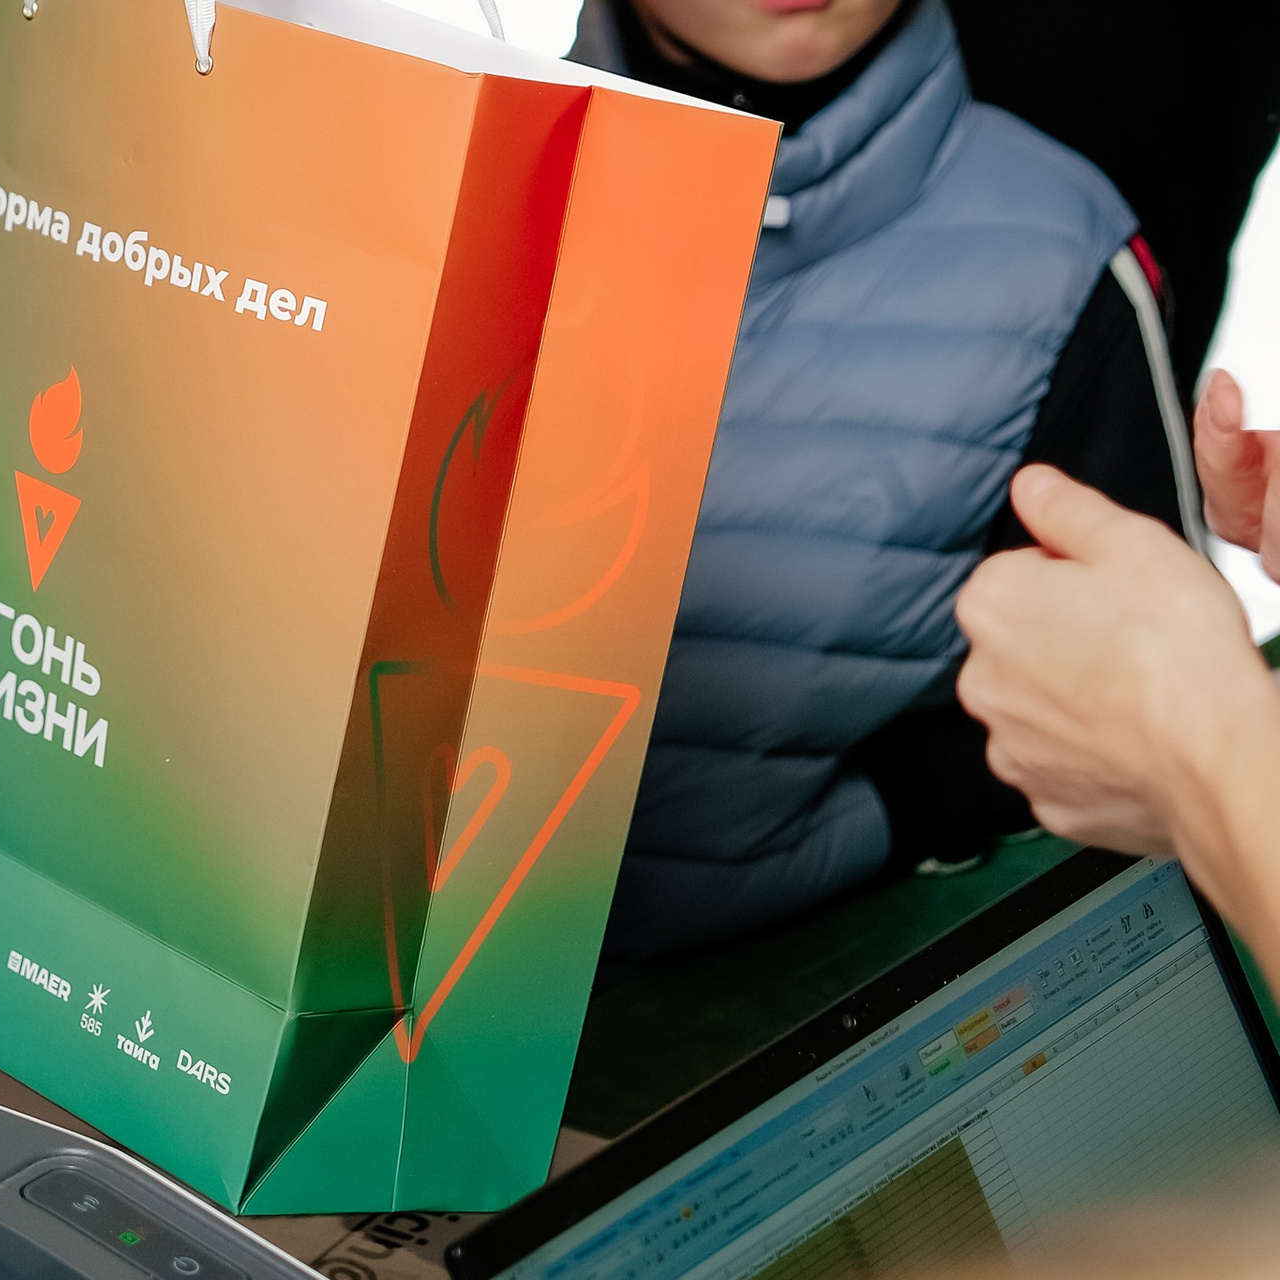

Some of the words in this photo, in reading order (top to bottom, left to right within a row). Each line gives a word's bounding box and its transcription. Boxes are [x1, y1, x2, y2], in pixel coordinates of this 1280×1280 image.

[76, 221, 229, 302] добрых
[236, 277, 328, 332] дел
[80, 1013, 103, 1037] 585
[176, 1048, 232, 1095] DARS
